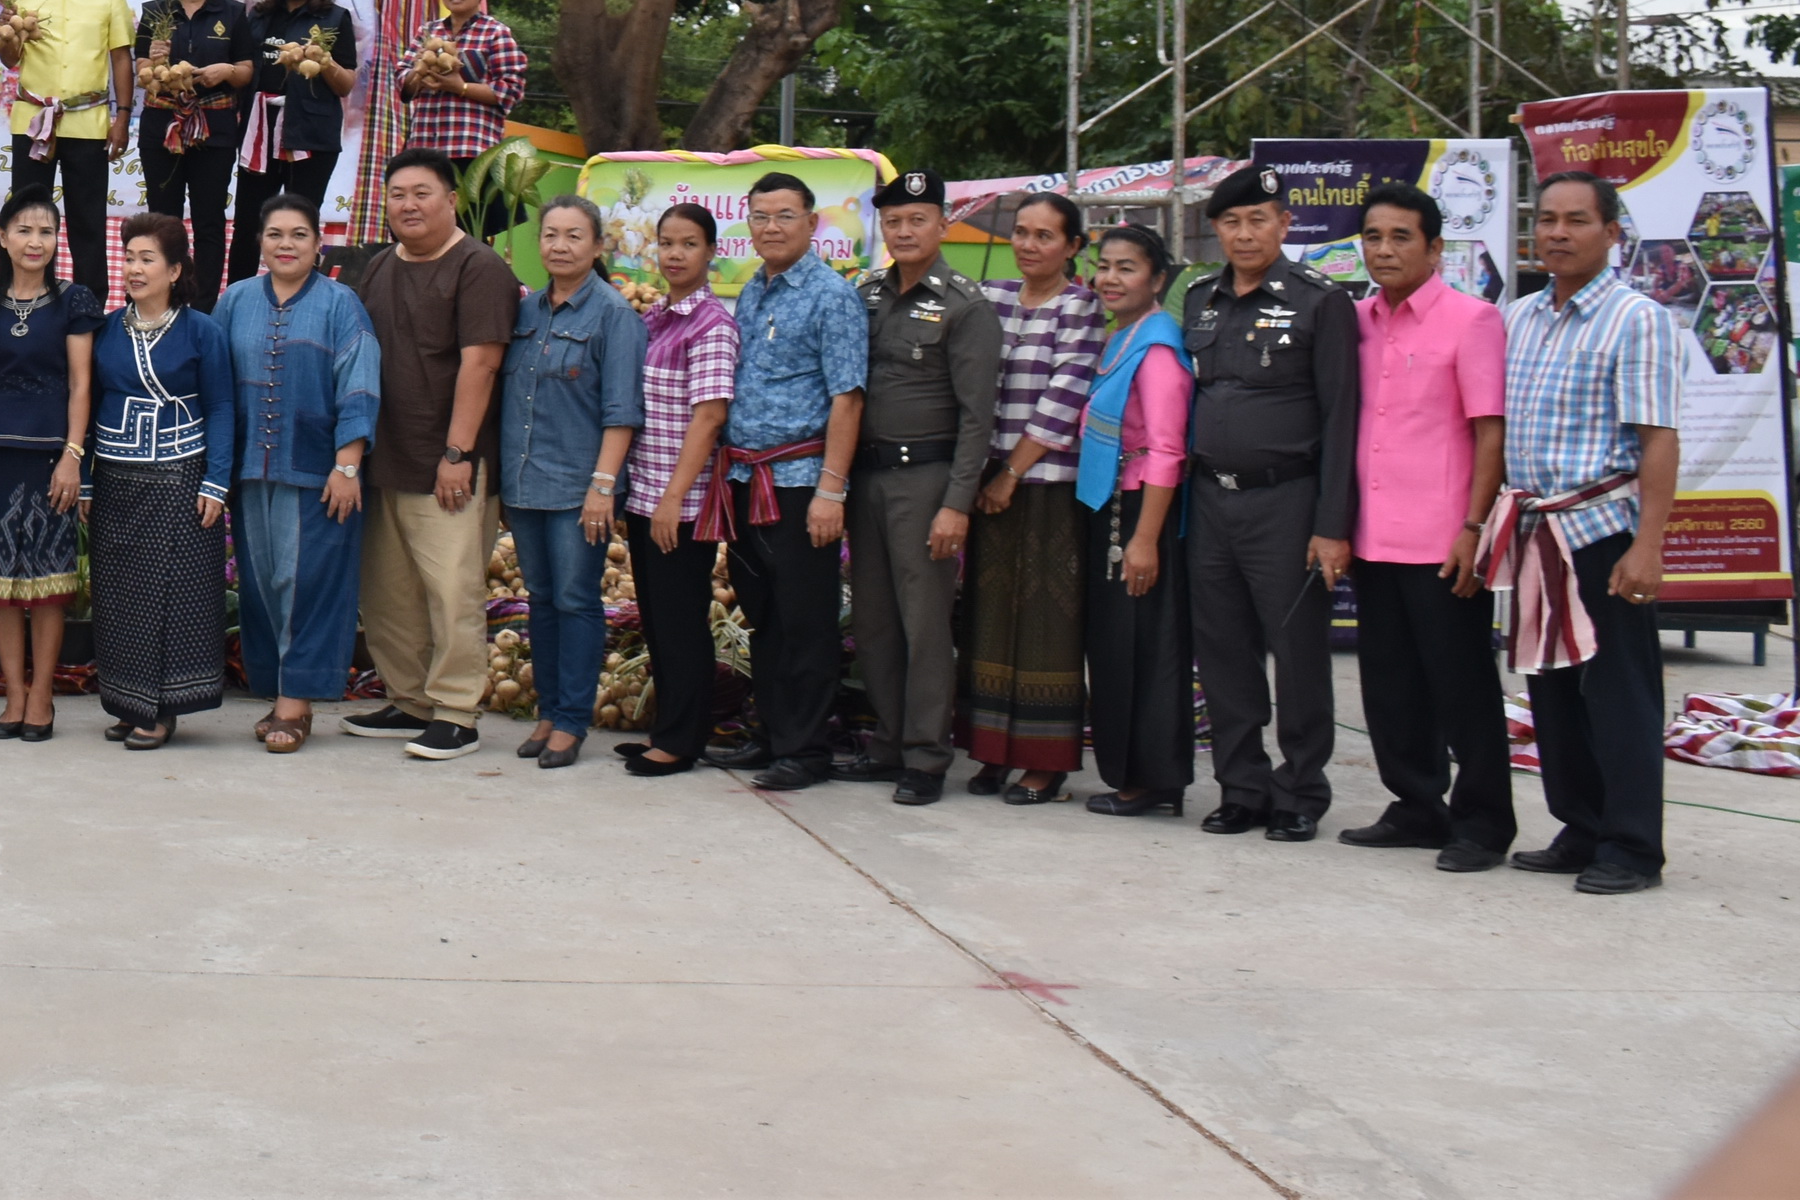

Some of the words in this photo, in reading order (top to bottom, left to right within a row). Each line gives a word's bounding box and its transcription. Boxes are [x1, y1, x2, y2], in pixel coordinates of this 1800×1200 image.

[1266, 160, 1354, 177] ลาดประชารัฐ
